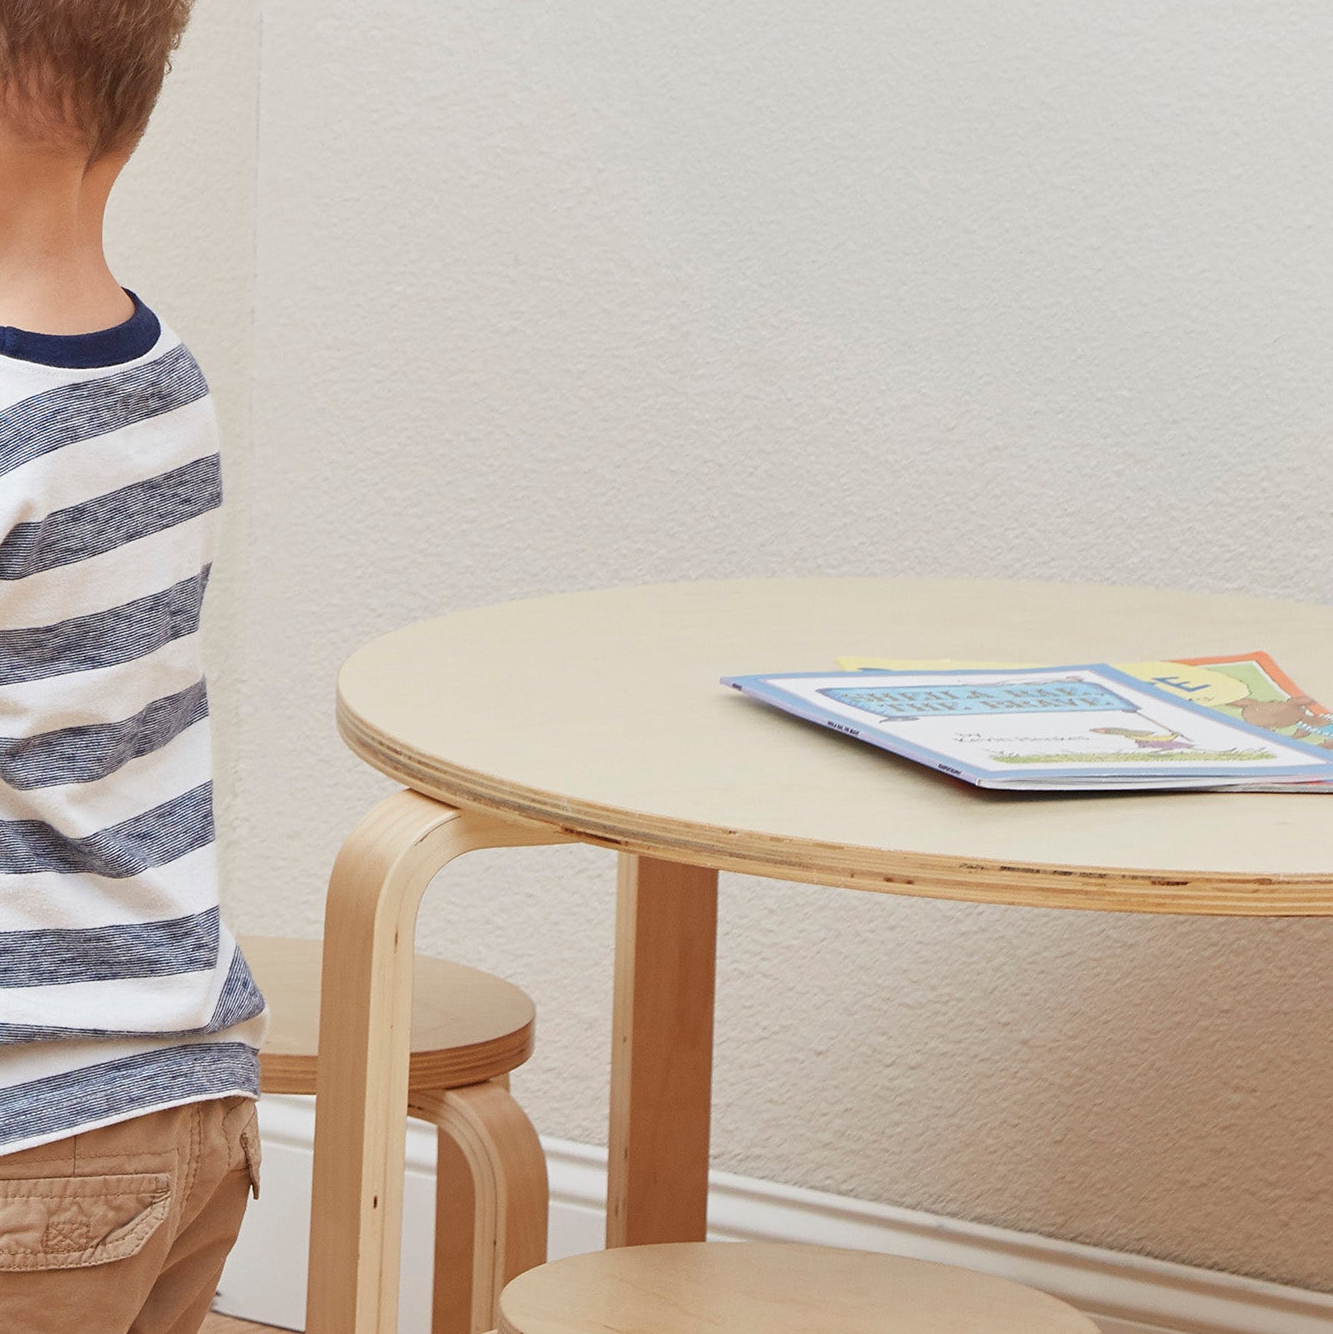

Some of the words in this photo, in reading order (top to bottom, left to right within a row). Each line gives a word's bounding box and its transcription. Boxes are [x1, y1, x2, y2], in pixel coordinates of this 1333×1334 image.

[842, 688, 994, 702] SHEILA
[878, 700, 972, 713] THE
[979, 697, 1115, 710] BRAVE
